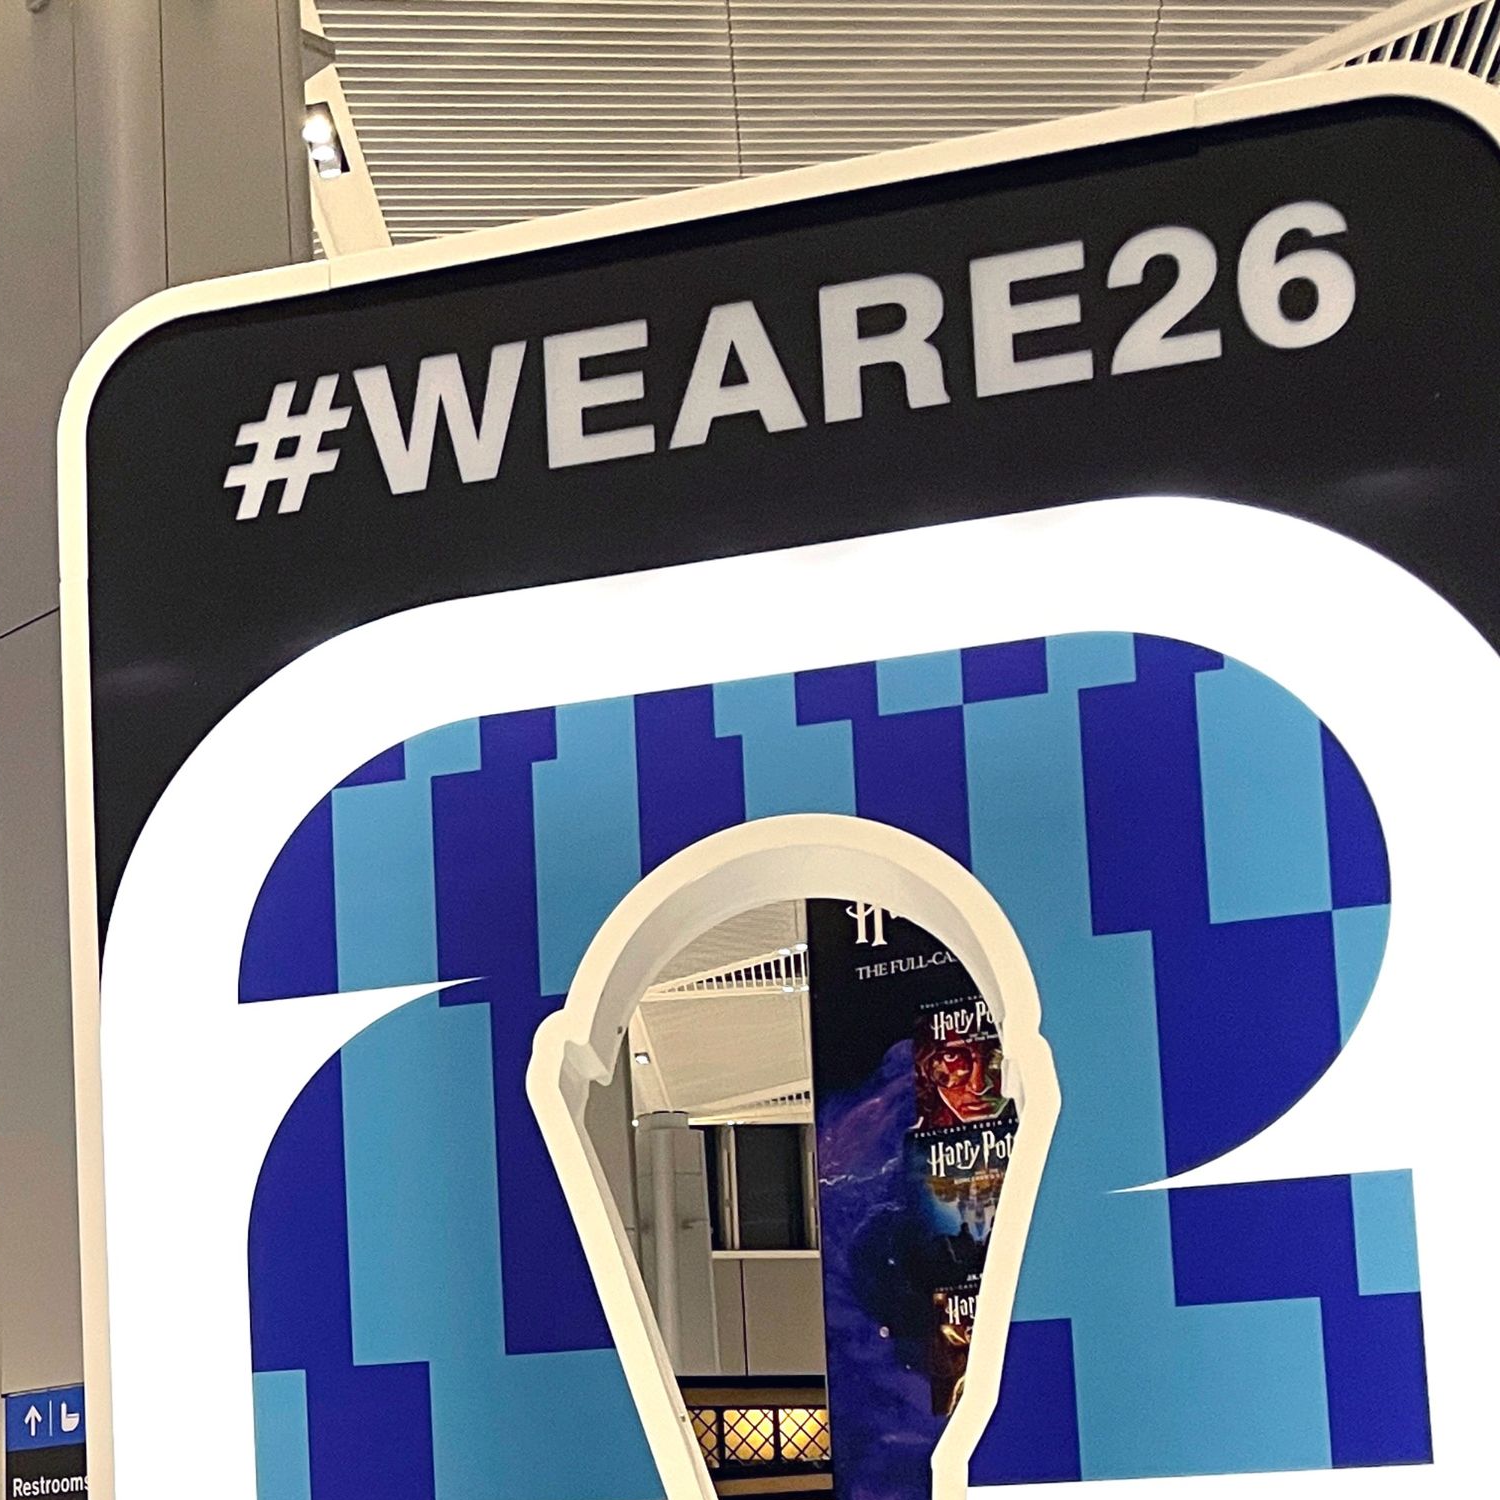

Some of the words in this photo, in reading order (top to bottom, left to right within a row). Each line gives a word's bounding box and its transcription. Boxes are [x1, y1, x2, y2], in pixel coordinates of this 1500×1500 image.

[221, 199, 1358, 521] #WEARE26
[855, 961, 888, 980] THE
[931, 1008, 974, 1041] Harry
[927, 1140, 980, 1177] Harry
